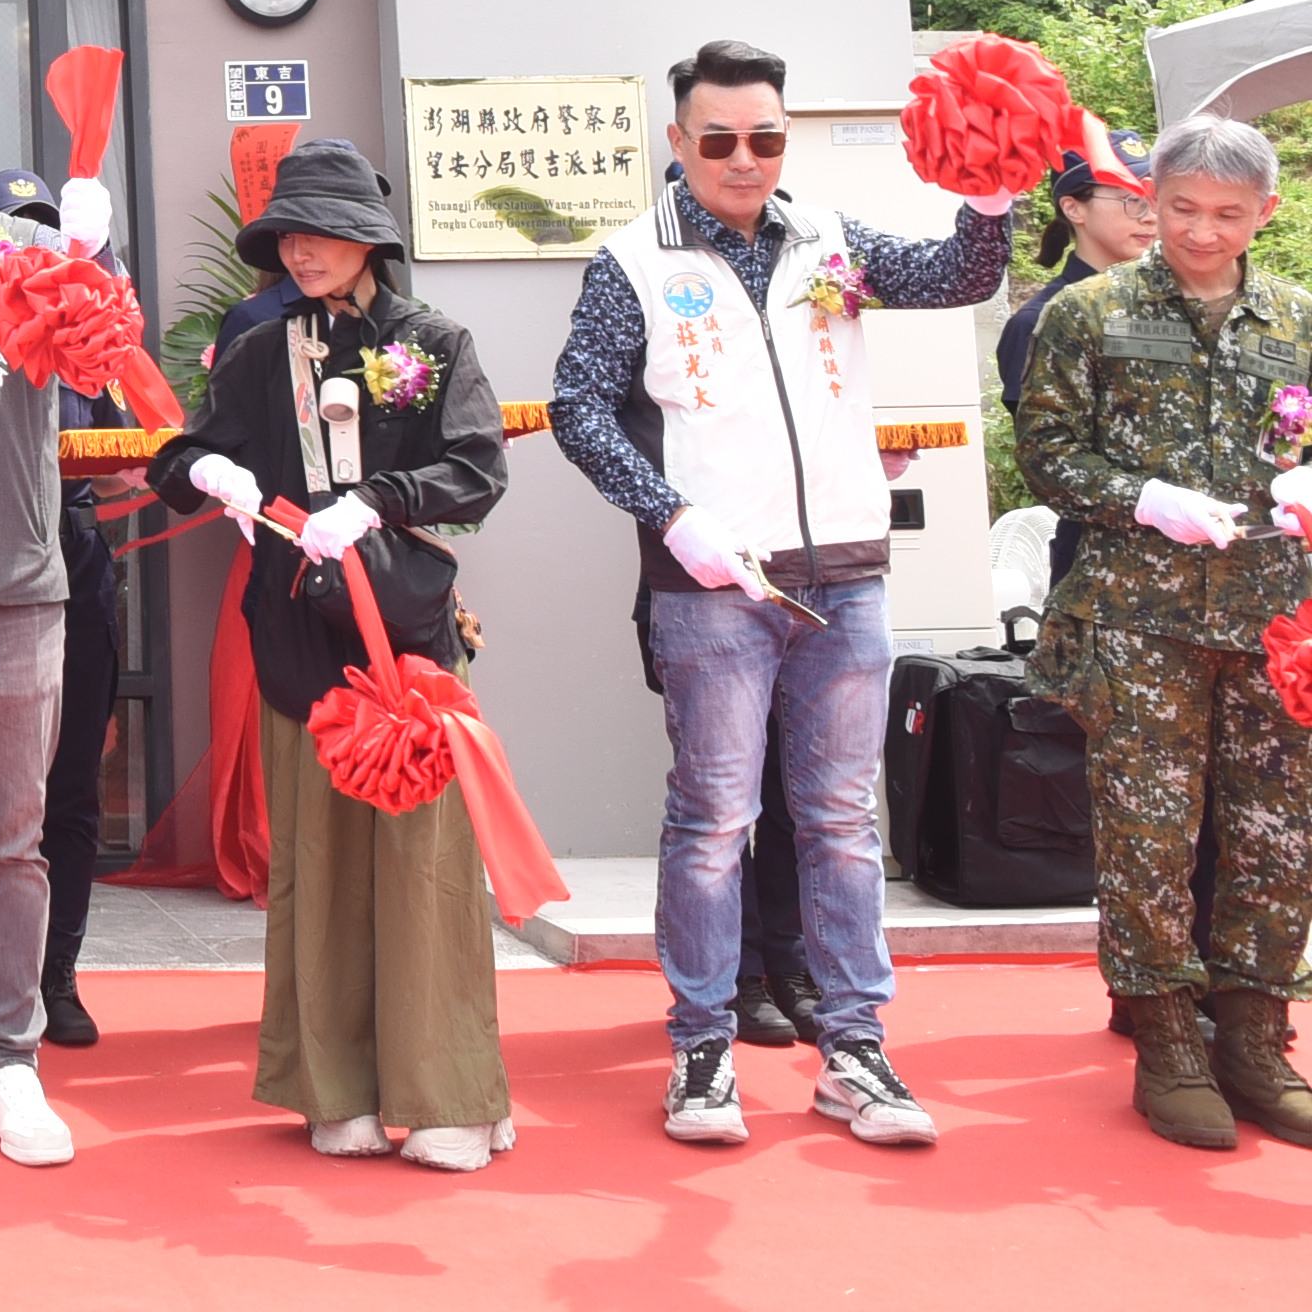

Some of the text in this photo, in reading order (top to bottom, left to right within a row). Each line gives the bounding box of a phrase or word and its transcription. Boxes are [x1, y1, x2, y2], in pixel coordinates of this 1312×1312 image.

[253, 66, 293, 81] 東吉
[265, 84, 284, 115] 9
[423, 104, 631, 137] 澎湖縣政府警察局
[426, 148, 633, 180] 望安分局雙吉派出所
[428, 200, 471, 214] Shuangji
[473, 199, 503, 211] Police
[592, 198, 636, 211] Precinct,
[431, 218, 467, 232] Penghu
[469, 218, 504, 231] County
[568, 215, 598, 228] Police
[676, 320, 717, 410] 莊光大
